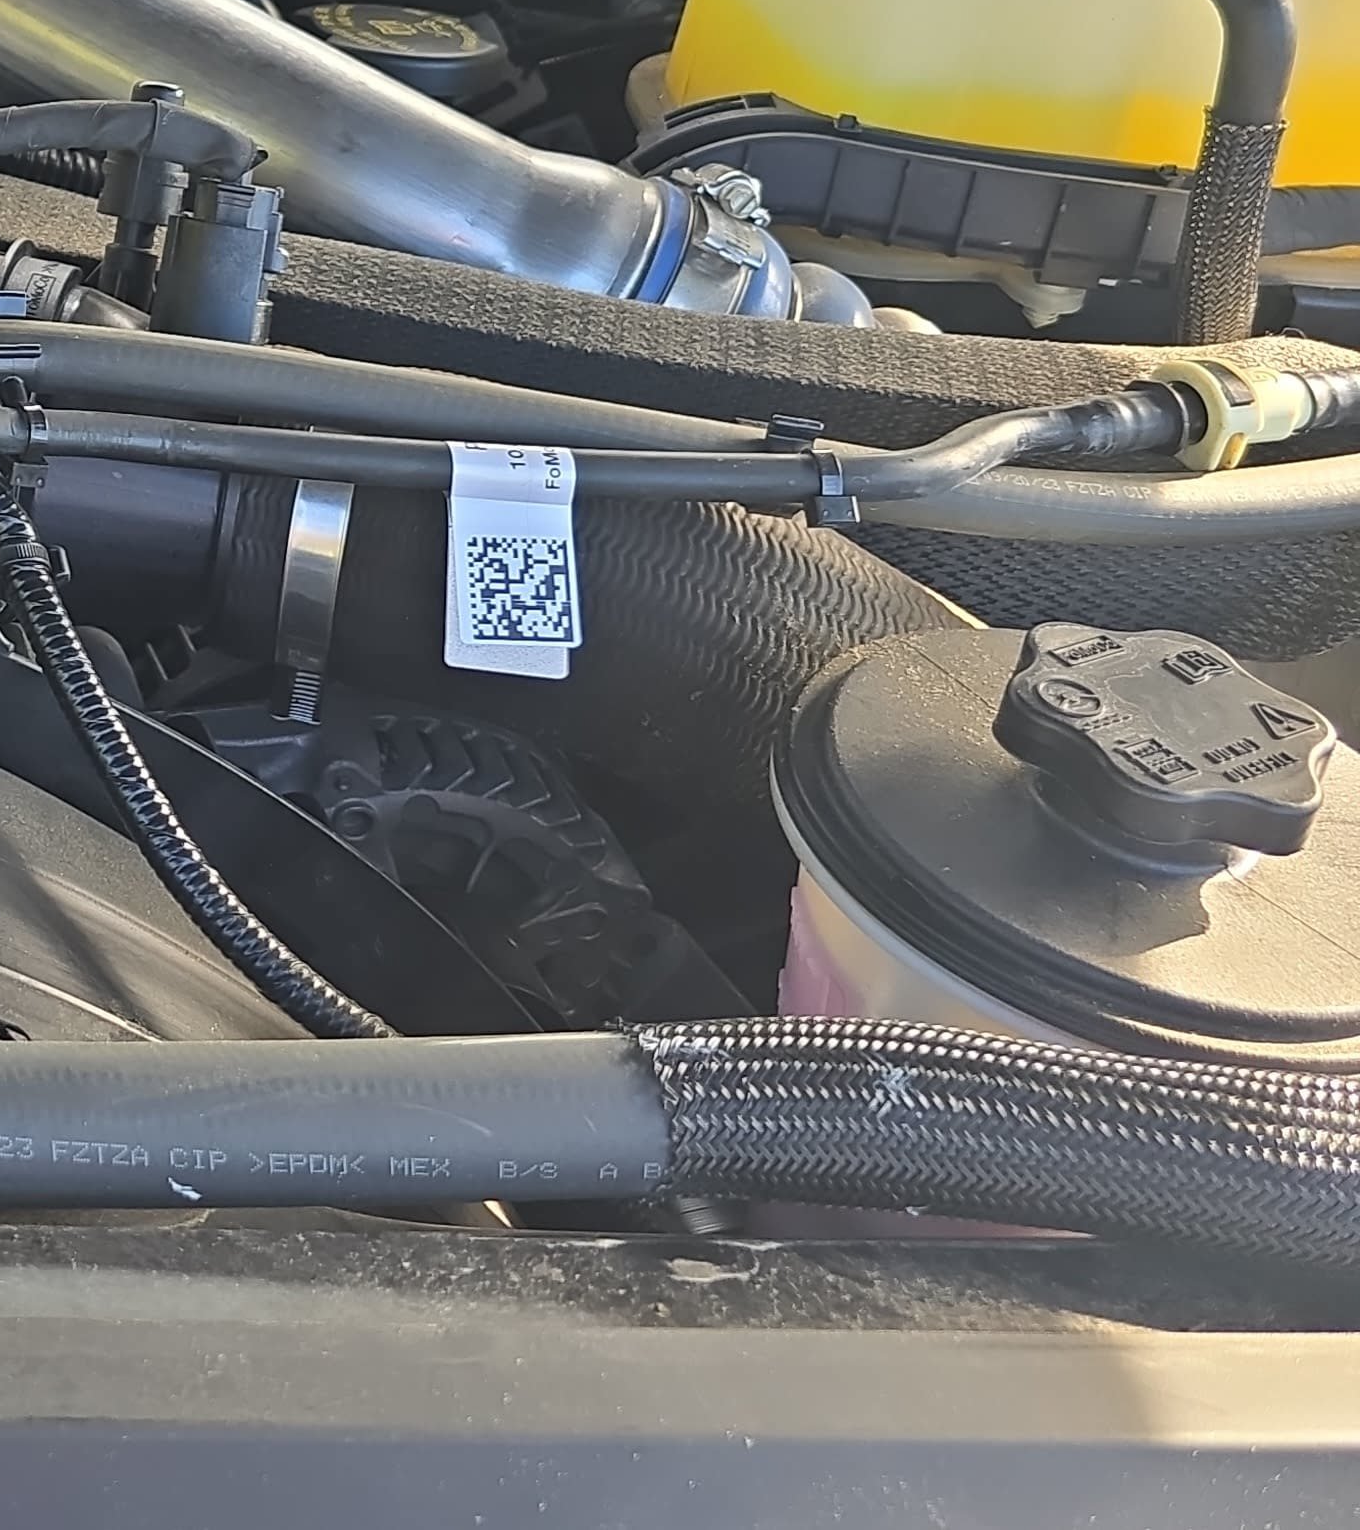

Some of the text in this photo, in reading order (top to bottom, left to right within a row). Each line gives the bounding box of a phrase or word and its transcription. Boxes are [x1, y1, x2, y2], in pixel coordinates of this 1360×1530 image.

[51, 1139, 150, 1168] FZTZA
[169, 1147, 228, 1172] CIP
[389, 1155, 451, 1180] MEX
[599, 1162, 619, 1180] A
